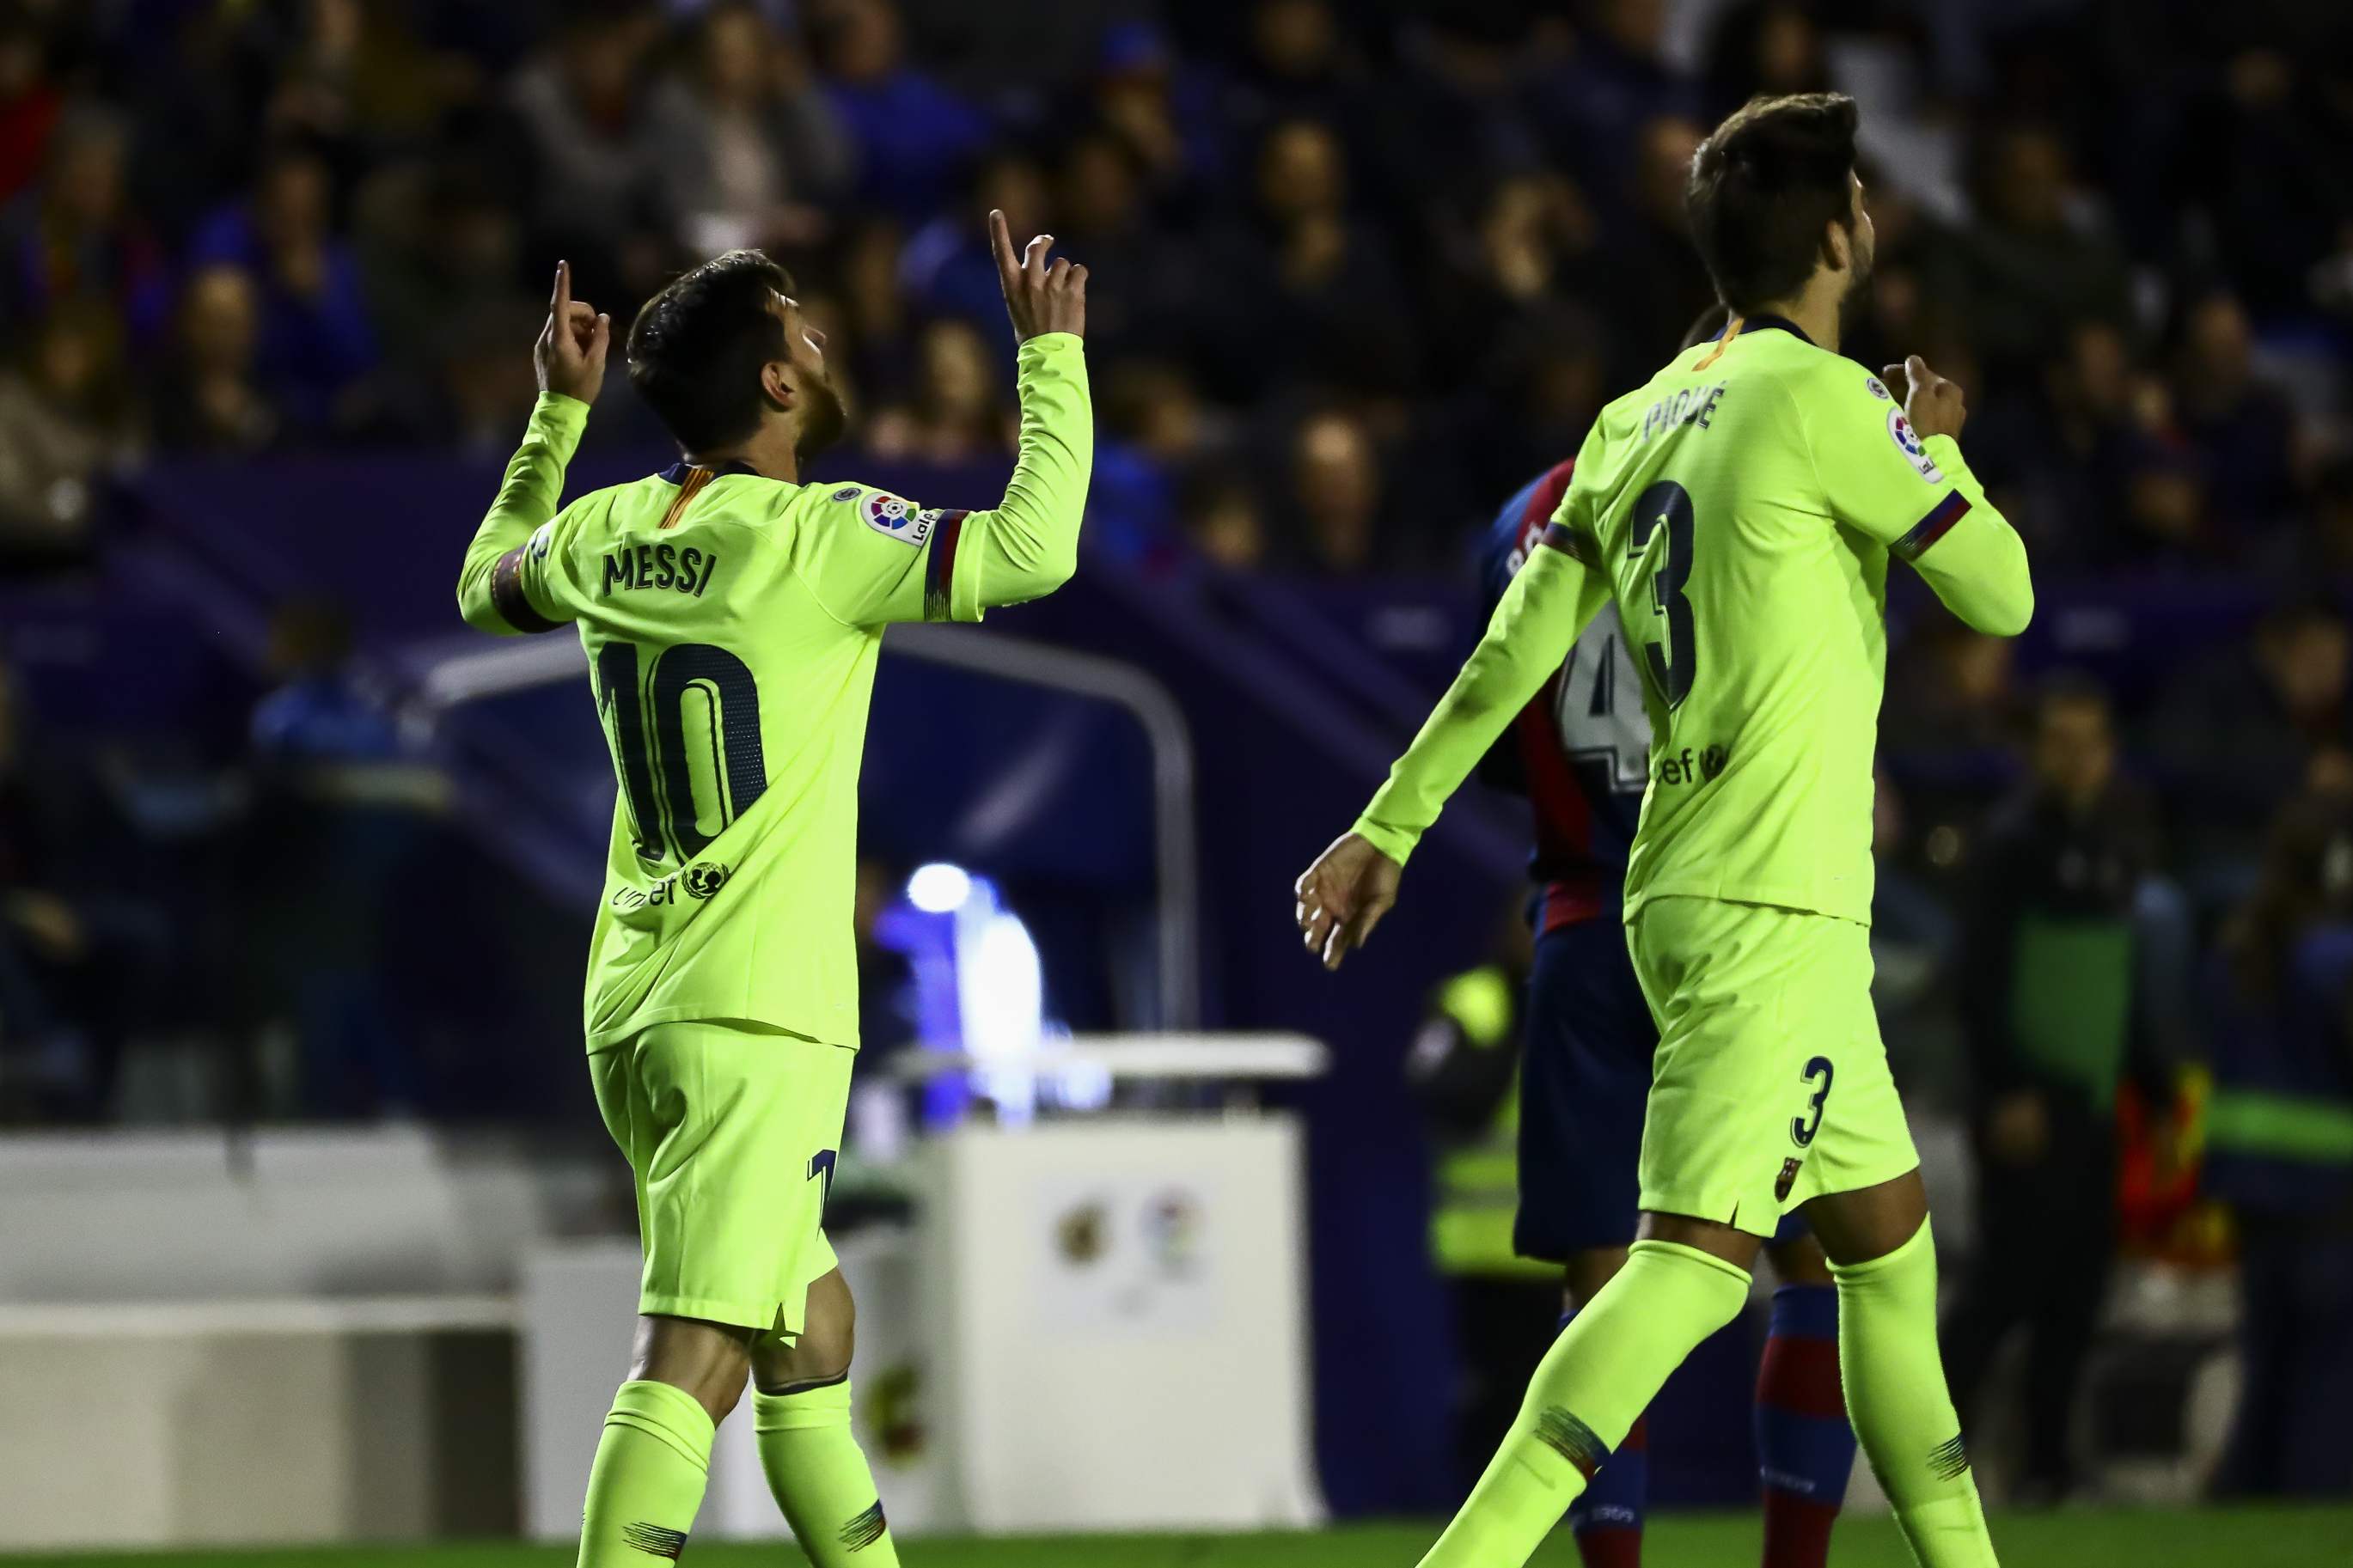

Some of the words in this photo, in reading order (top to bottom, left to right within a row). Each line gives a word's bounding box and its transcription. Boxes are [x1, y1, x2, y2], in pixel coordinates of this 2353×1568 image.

[602, 544, 717, 597] MESSI
[1628, 479, 1696, 714] 3
[596, 641, 767, 868] 10
[1555, 597, 1654, 793] 4
[1790, 1056, 1834, 1148] 3
